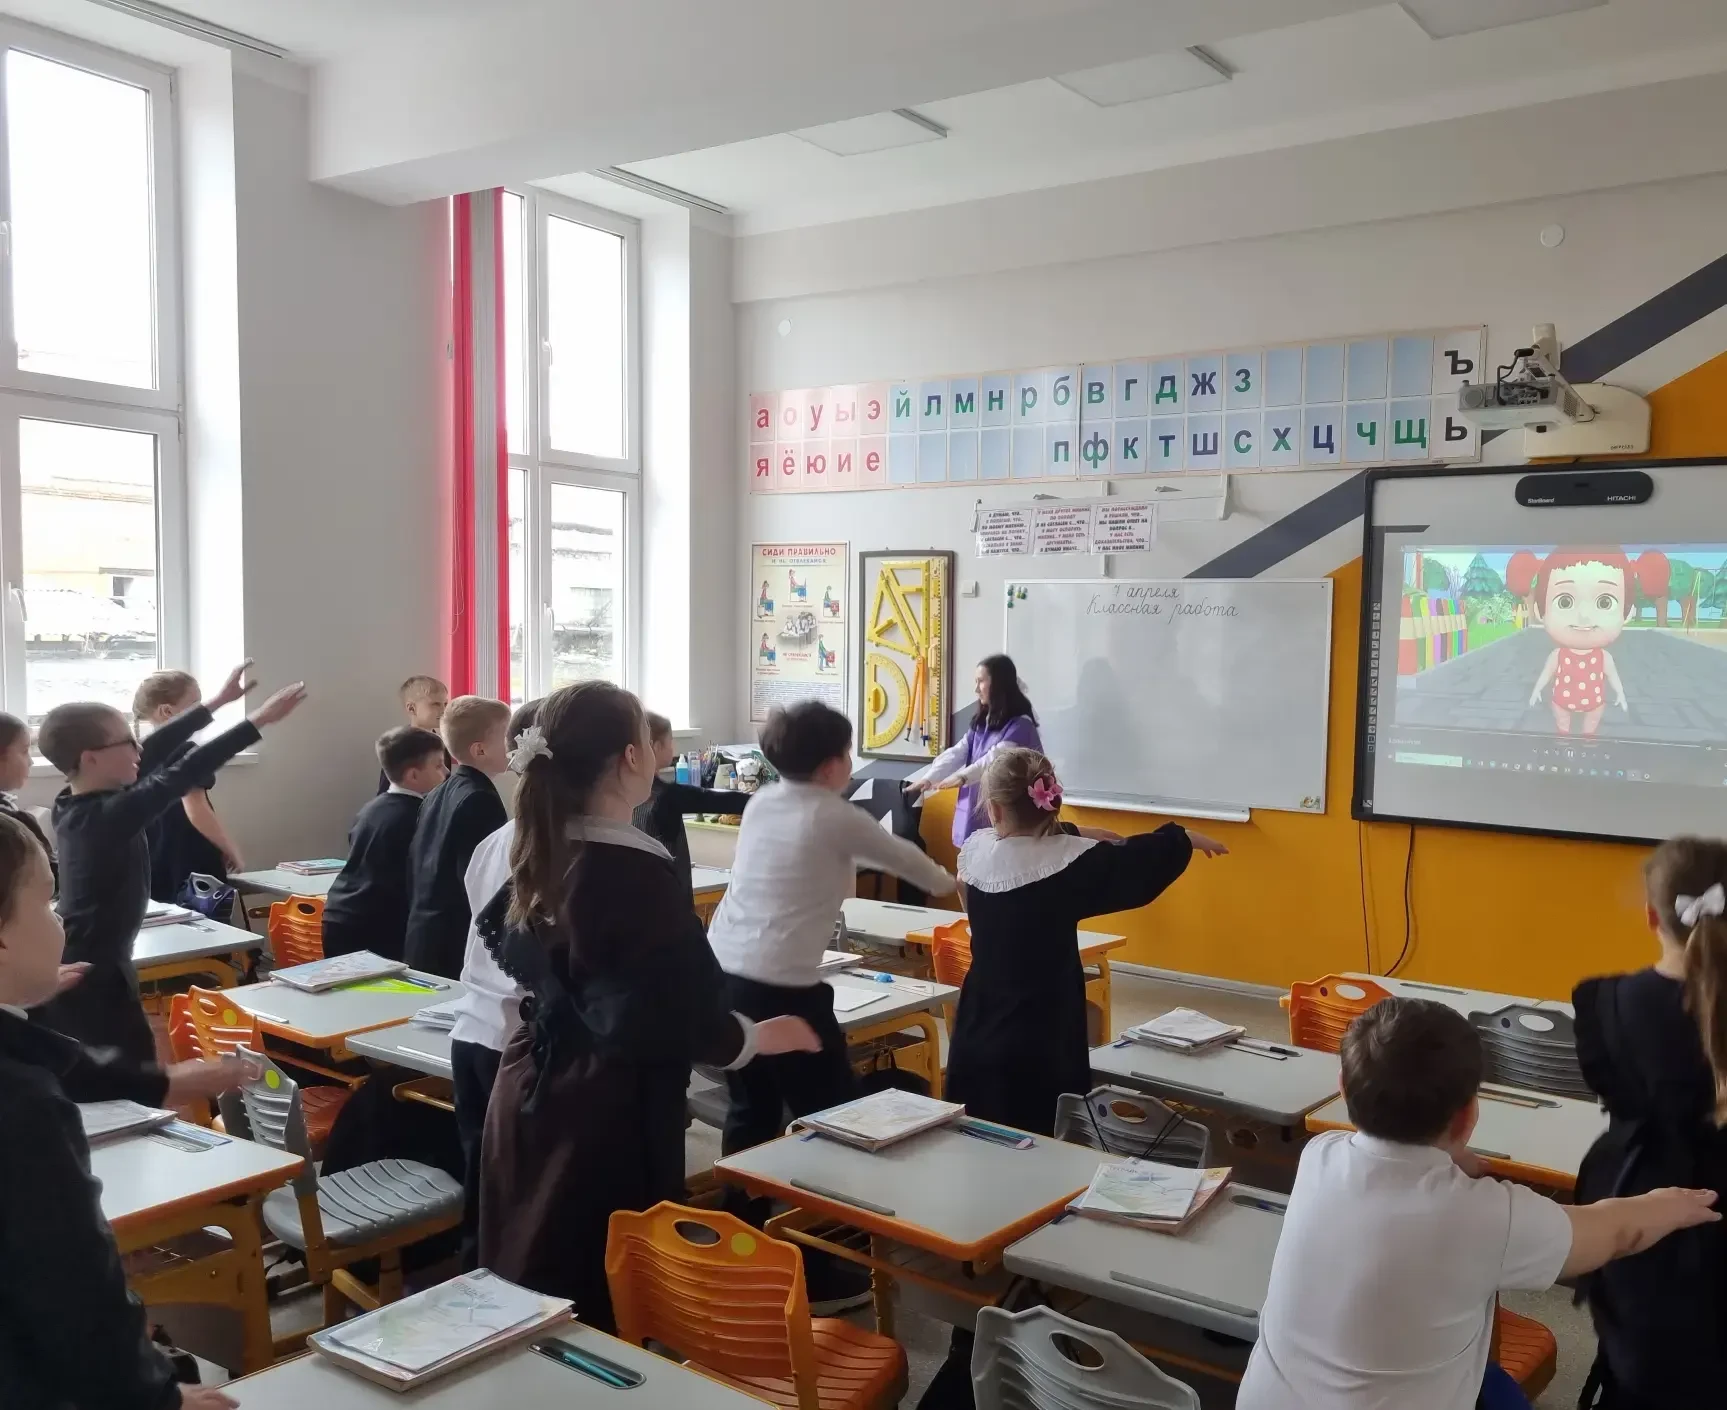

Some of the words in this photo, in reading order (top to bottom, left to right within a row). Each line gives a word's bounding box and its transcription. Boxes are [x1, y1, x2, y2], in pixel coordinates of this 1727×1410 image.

[762, 548, 784, 556] СИДИ
[788, 547, 836, 556] ПРАВИЛЬНО
[1126, 586, 1180, 608] апреля
[1086, 593, 1162, 615] Классная
[1167, 596, 1239, 625] работа
